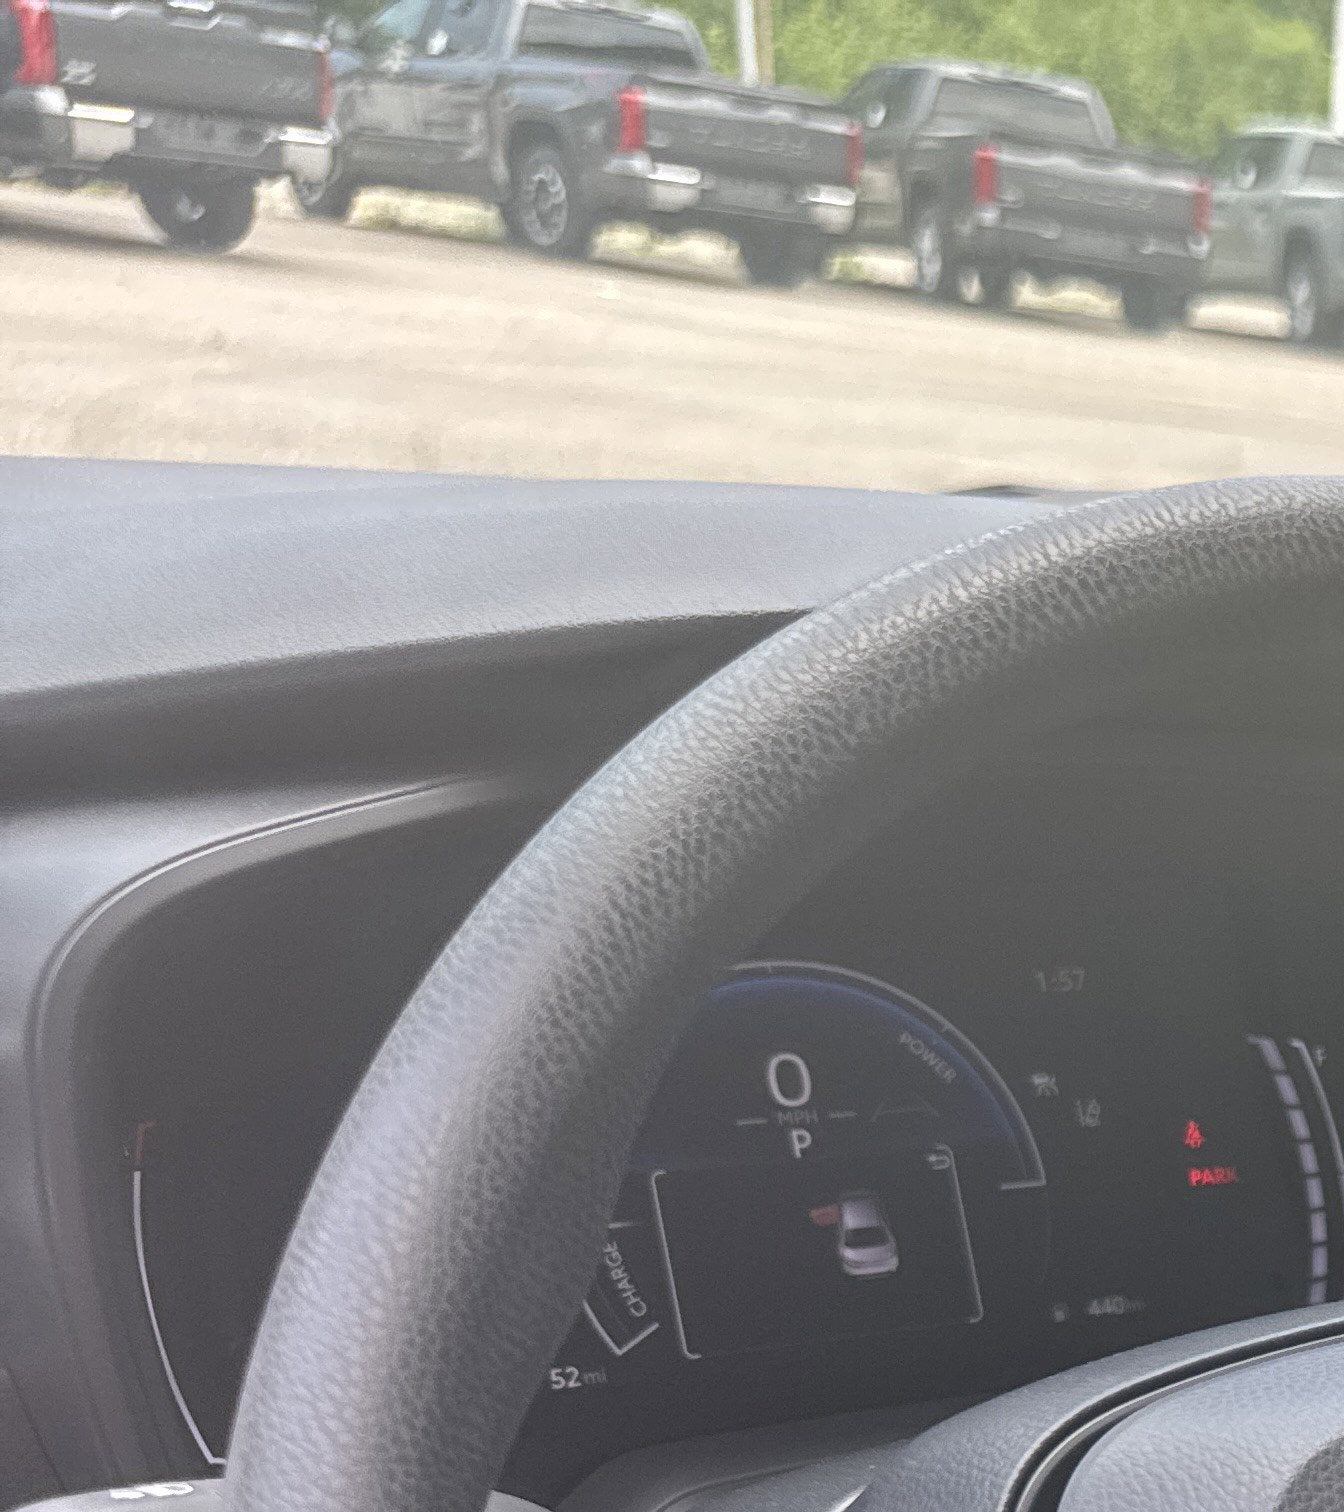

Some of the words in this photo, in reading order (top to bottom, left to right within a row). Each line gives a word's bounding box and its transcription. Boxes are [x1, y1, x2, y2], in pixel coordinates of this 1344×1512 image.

[1034, 968, 1086, 993] 1:57
[899, 1031, 957, 1083] POWER
[768, 1053, 812, 1107] 0
[778, 1109, 819, 1126] MPH
[791, 1129, 812, 1159] P
[1187, 1167, 1237, 1187] PARK
[603, 1241, 648, 1318] CHARGE
